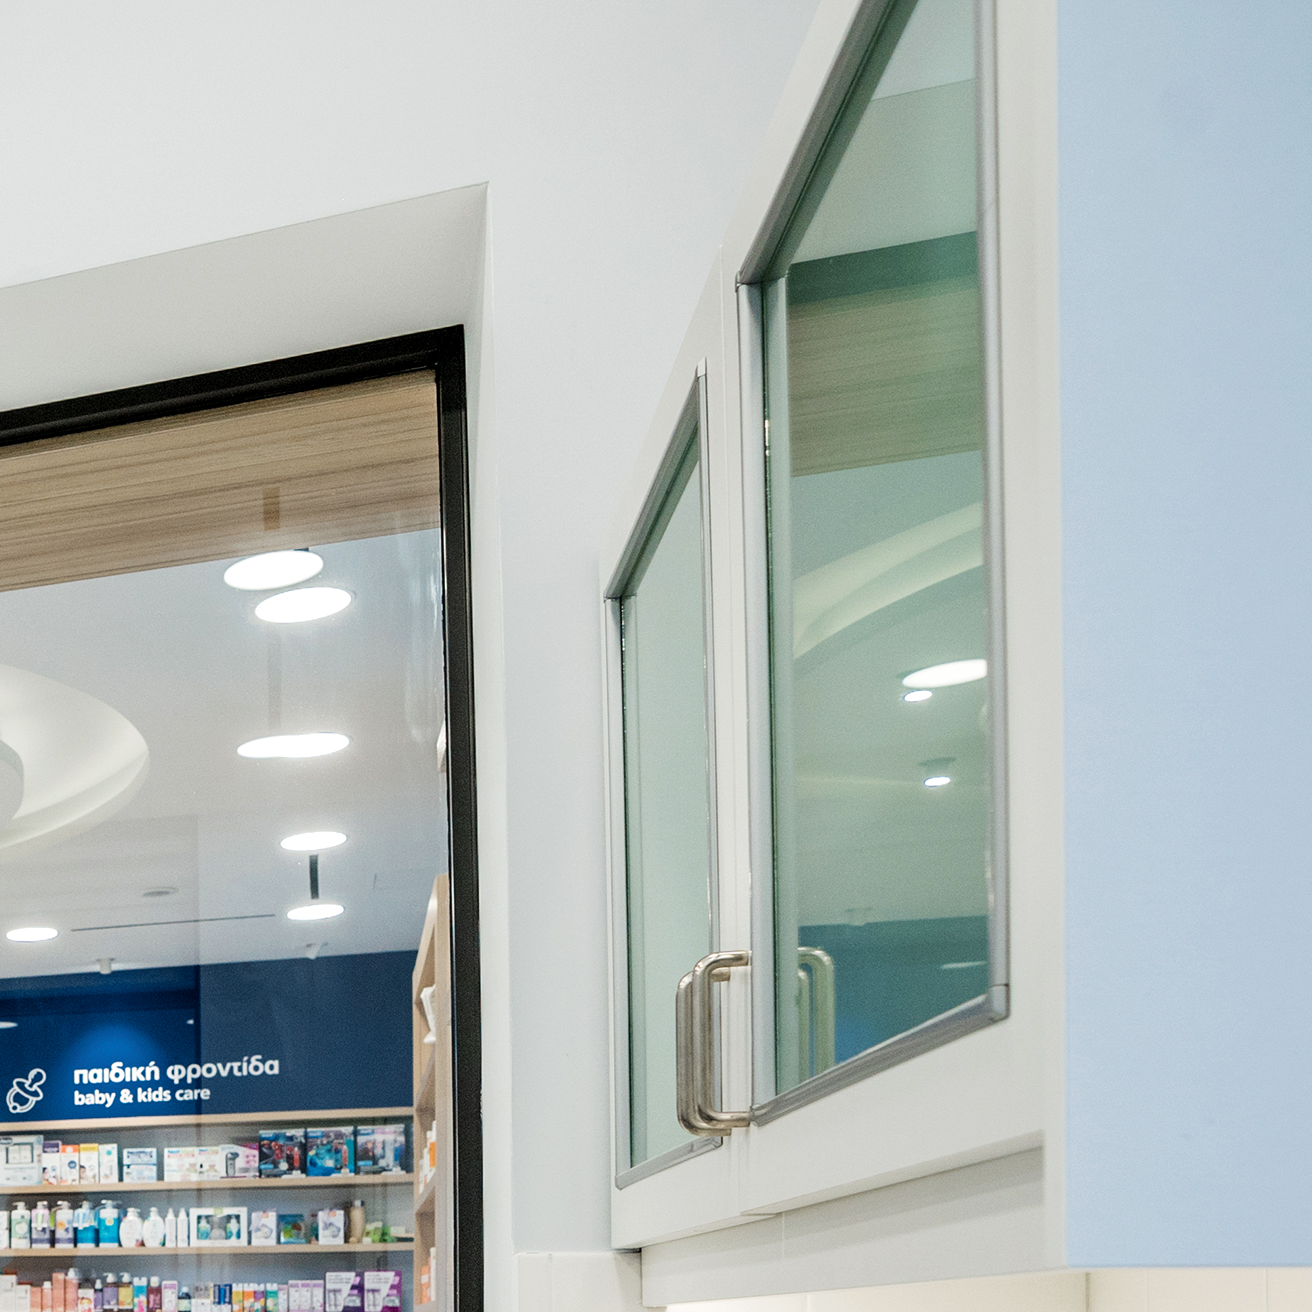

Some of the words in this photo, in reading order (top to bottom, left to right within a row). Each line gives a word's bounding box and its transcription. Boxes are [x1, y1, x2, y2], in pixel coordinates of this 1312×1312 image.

[73, 1061, 160, 1084] παιδική
[166, 1055, 280, 1085] φροντίδα
[74, 1089, 116, 1108] baby
[119, 1088, 134, 1104] &
[137, 1086, 172, 1103] kids
[175, 1087, 211, 1101] care
